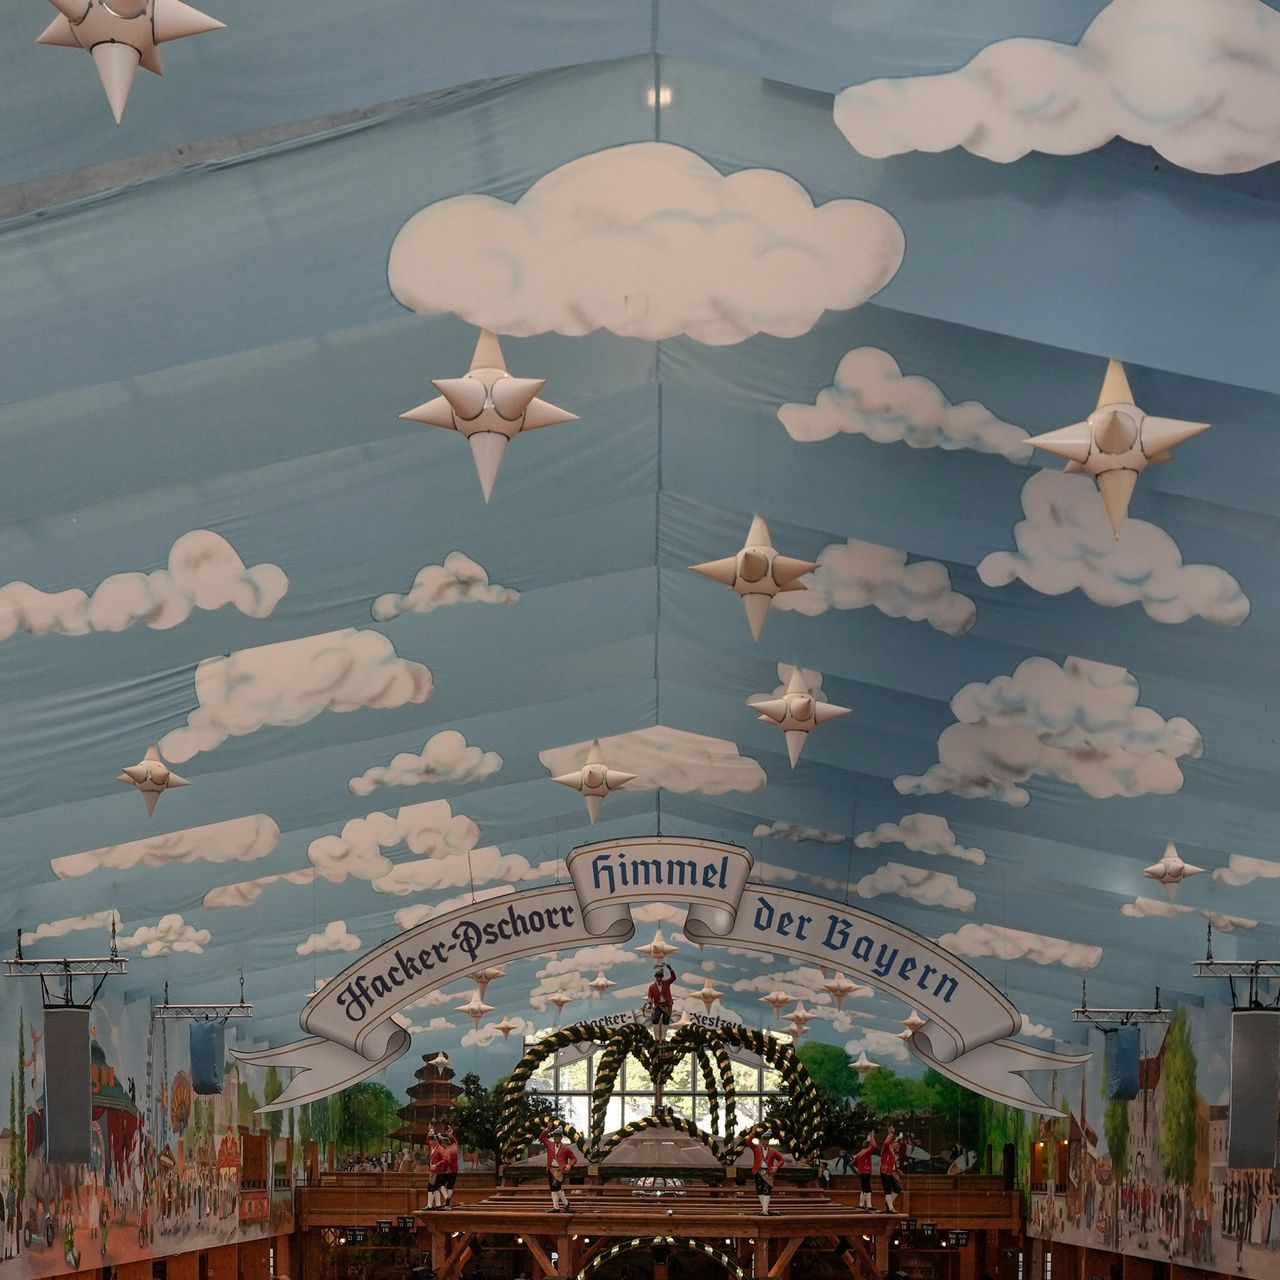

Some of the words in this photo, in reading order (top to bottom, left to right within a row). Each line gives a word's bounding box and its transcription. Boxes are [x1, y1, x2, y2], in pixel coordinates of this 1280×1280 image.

[592, 853, 729, 894] Himmel
[337, 905, 575, 1021] Hacker-Pschorr
[754, 897, 813, 941] der
[822, 914, 959, 1003] Bayern
